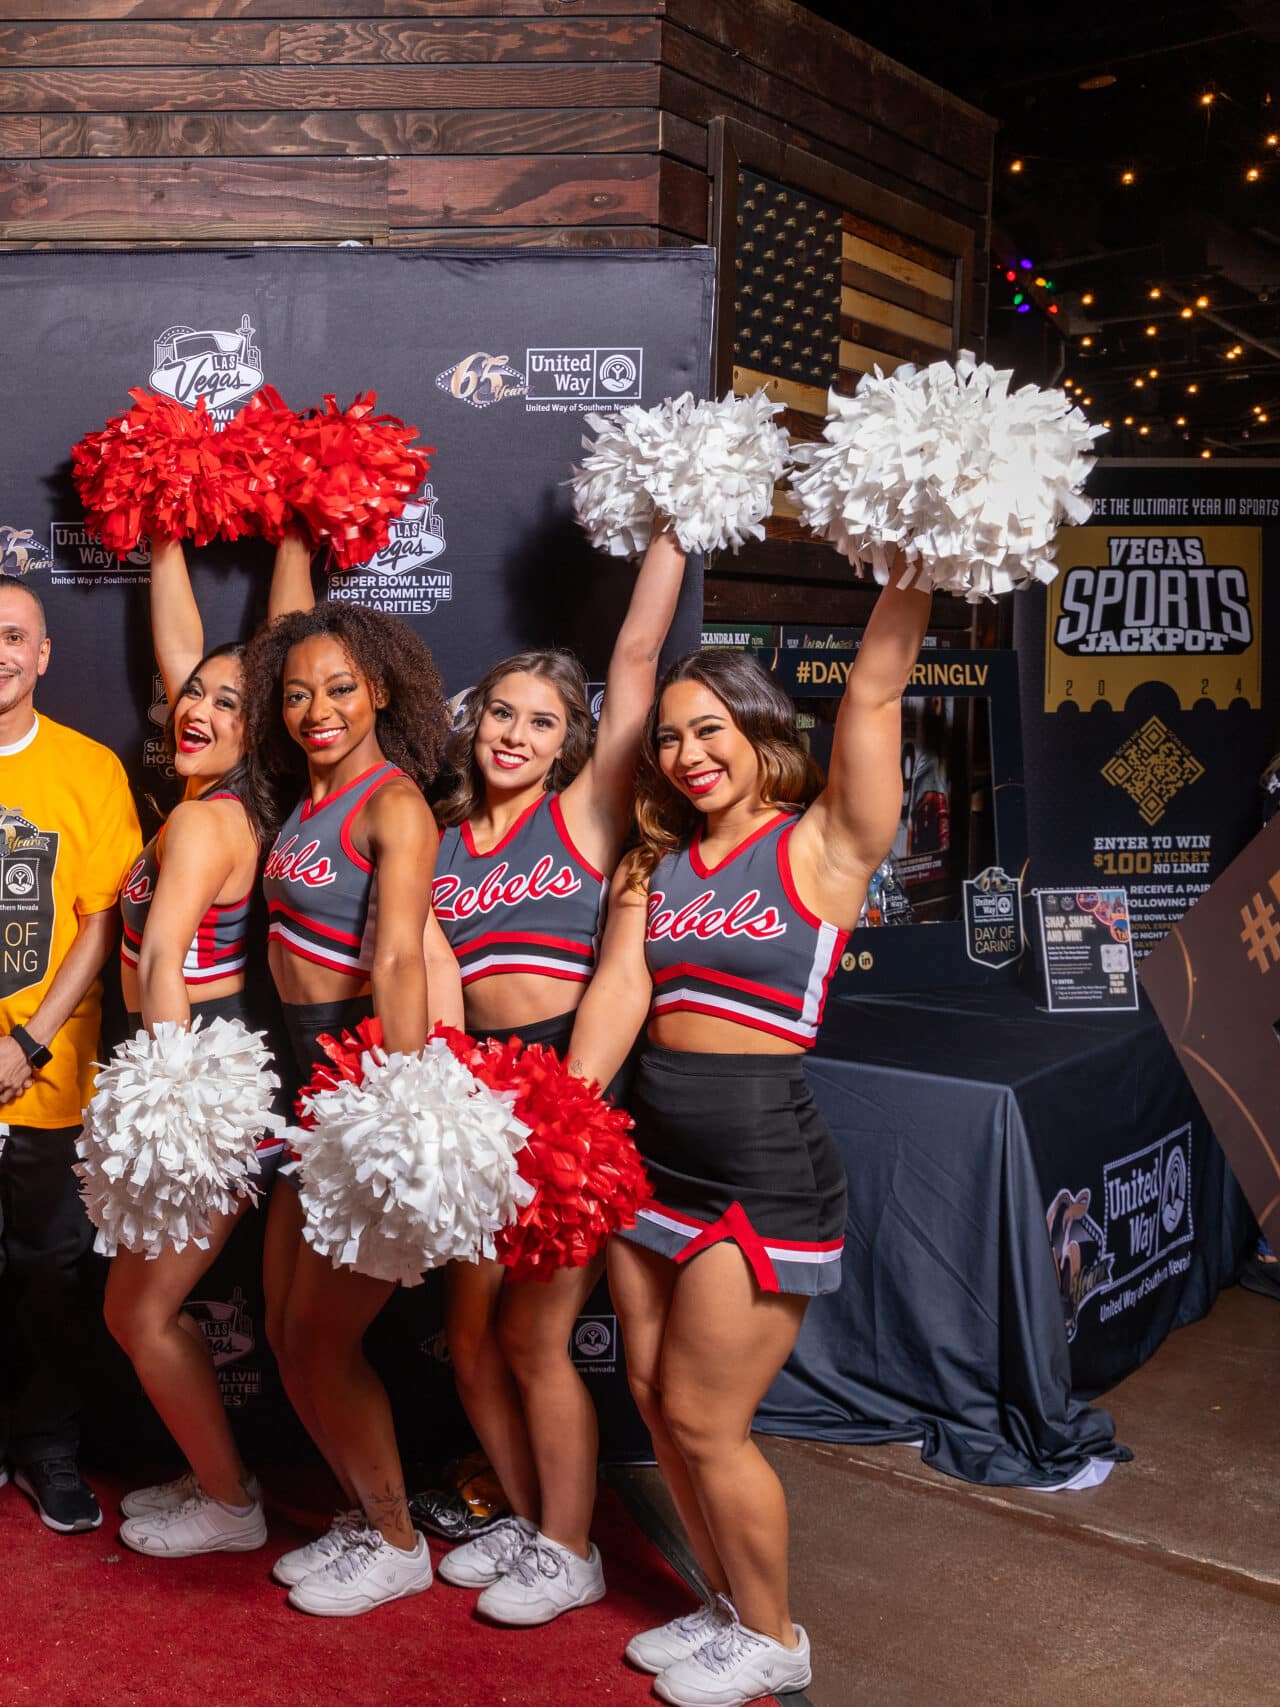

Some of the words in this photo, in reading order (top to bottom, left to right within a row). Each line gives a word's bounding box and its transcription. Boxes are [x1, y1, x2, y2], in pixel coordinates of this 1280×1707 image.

[213, 356, 237, 370] LAS
[531, 354, 591, 372] United
[164, 358, 251, 404] Vegas
[451, 351, 509, 404] 65
[554, 373, 590, 395] Way
[526, 403, 550, 412] United
[552, 403, 568, 413] Way
[569, 403, 577, 412] of
[578, 403, 612, 412] Southern
[1110, 499, 1130, 516] THE
[1133, 498, 1189, 516] ULTIMATE
[1192, 498, 1221, 516] YEAR
[1225, 499, 1236, 515] IN
[1239, 499, 1280, 516] SPORTS
[55, 528, 103, 545] Unite
[397, 524, 419, 537] LAS
[80, 547, 114, 568] Way
[1109, 538, 1204, 566] VEGAS
[51, 576, 76, 585] United
[77, 576, 94, 585] Way
[95, 576, 102, 584] of
[103, 576, 137, 585] Southern
[331, 576, 376, 587] SUPER
[378, 576, 419, 587] BOWL
[422, 575, 450, 586] LVIII
[330, 588, 367, 599] HOST
[370, 588, 450, 599] COMMITTEE
[1057, 569, 1251, 645] SPORTS
[735, 633, 750, 645] KAY
[1078, 627, 1229, 653] JACKPOT
[1094, 837, 1148, 850] ENTER
[1152, 836, 1172, 849] TO
[1176, 836, 1211, 849] WIN
[1094, 852, 1152, 874] $100
[1154, 852, 1211, 863] TICKET
[1153, 863, 1170, 874] NO
[1173, 863, 1210, 873] LIMIT
[431, 855, 581, 921] Rebels
[1130, 884, 1174, 894] RECEIVE
[1176, 884, 1184, 894] A
[17, 903, 38, 911] Nevada
[5, 922, 39, 947] OF
[975, 928, 997, 940] DAY
[1000, 926, 1015, 939] OF
[975, 939, 1016, 954] CARING
[1107, 1157, 1160, 1220] United
[1129, 1212, 1157, 1257] Way
[1100, 1292, 1123, 1322] United
